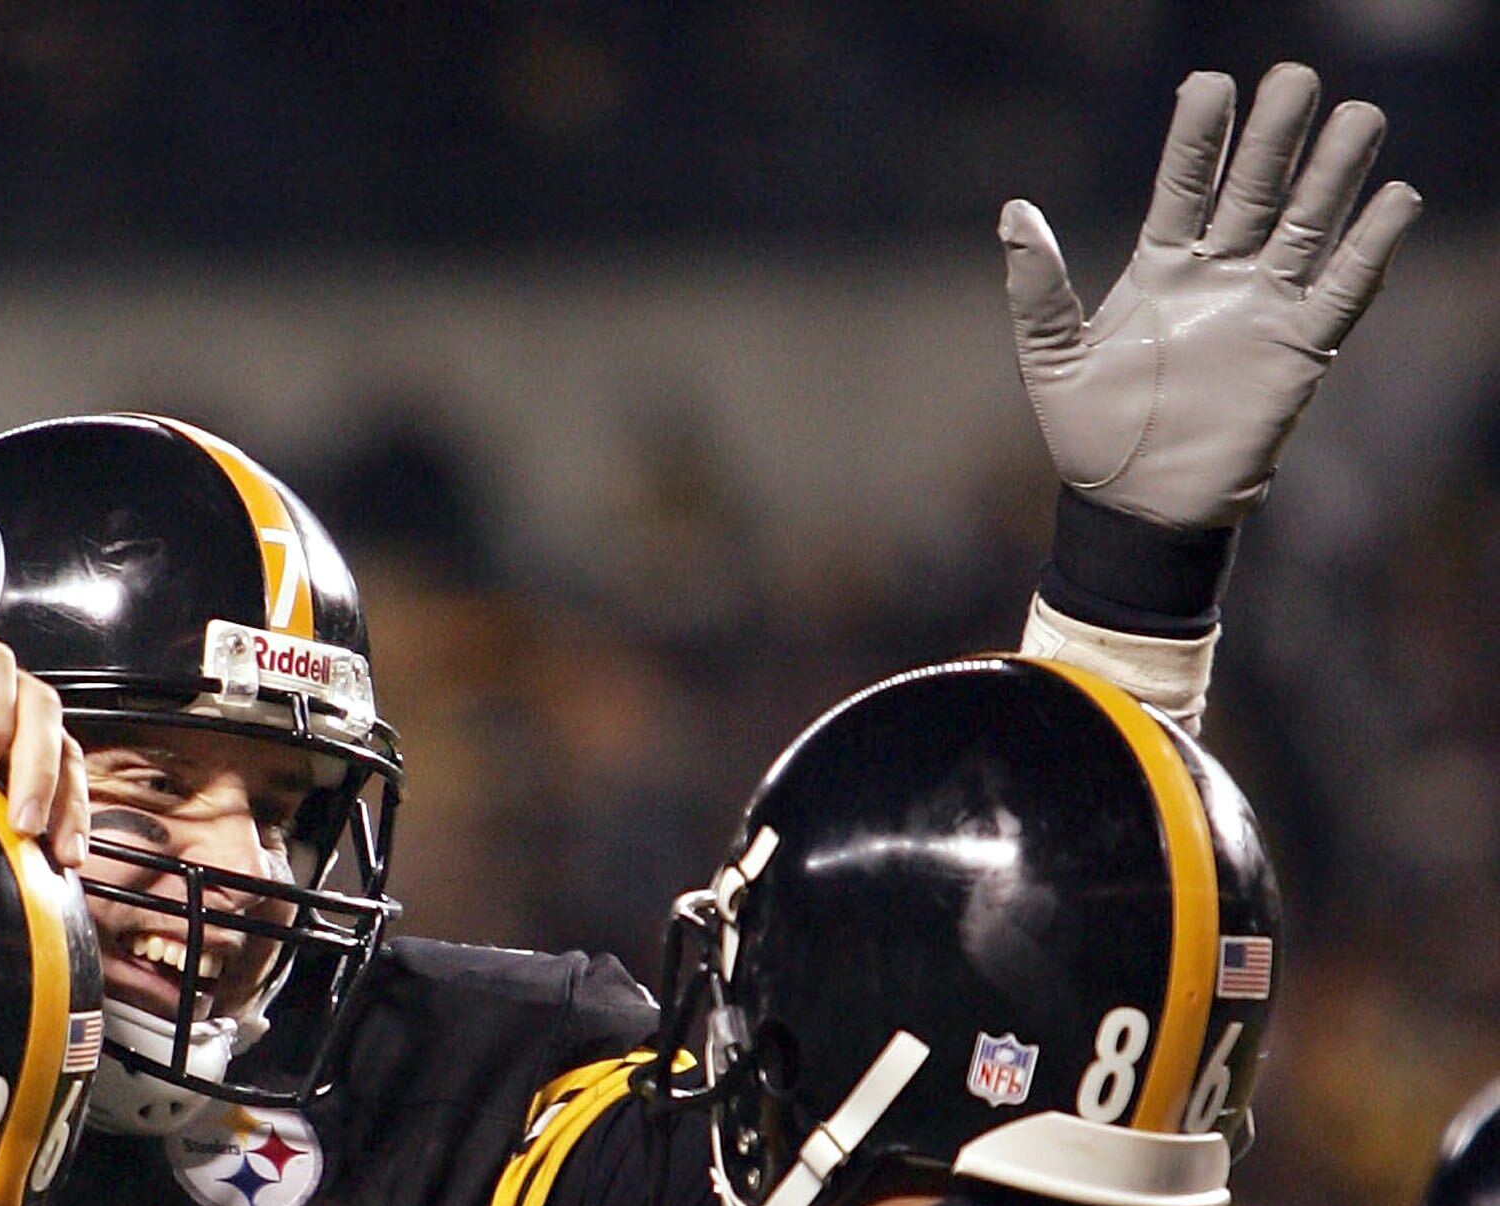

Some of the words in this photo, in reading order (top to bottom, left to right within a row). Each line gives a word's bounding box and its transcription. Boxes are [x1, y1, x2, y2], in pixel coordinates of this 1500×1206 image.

[260, 527, 302, 629] 7
[252, 635, 332, 685] Riddell
[977, 1061, 1022, 1096] NFL
[1076, 1005, 1244, 1134] 86
